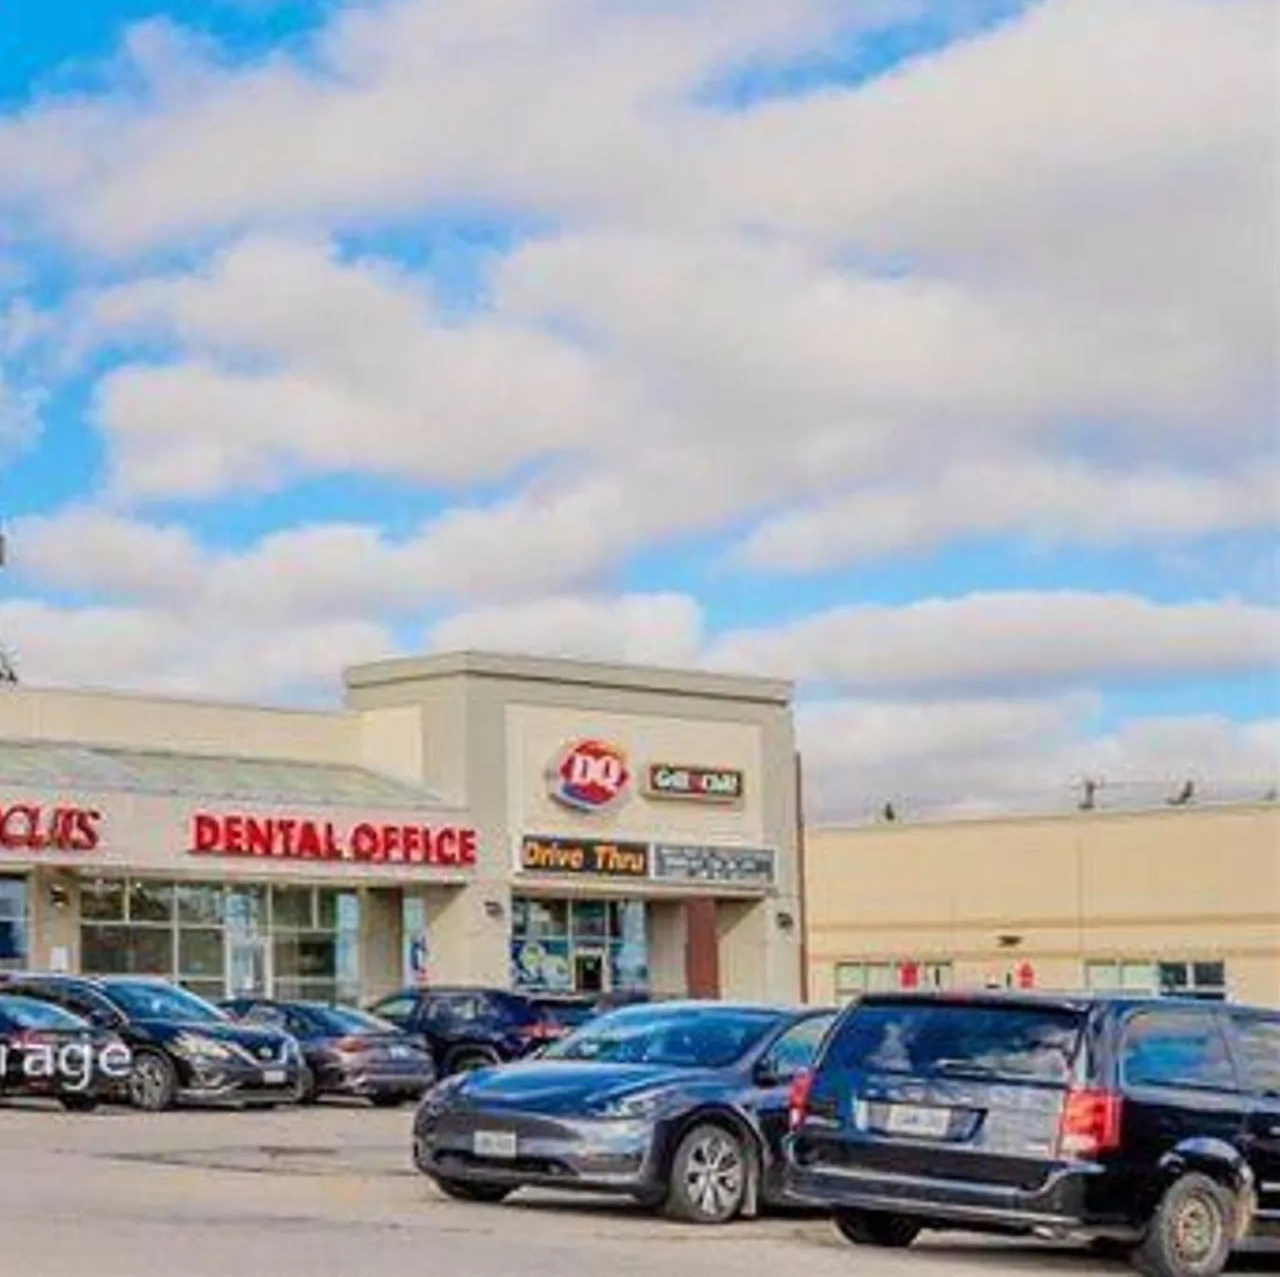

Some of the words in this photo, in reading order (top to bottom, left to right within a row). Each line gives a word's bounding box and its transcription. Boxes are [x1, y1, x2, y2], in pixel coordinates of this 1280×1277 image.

[191, 814, 343, 860] DENTAL
[351, 824, 477, 866] OFFICE
[523, 841, 584, 868] Drive
[594, 844, 644, 871] Thru
